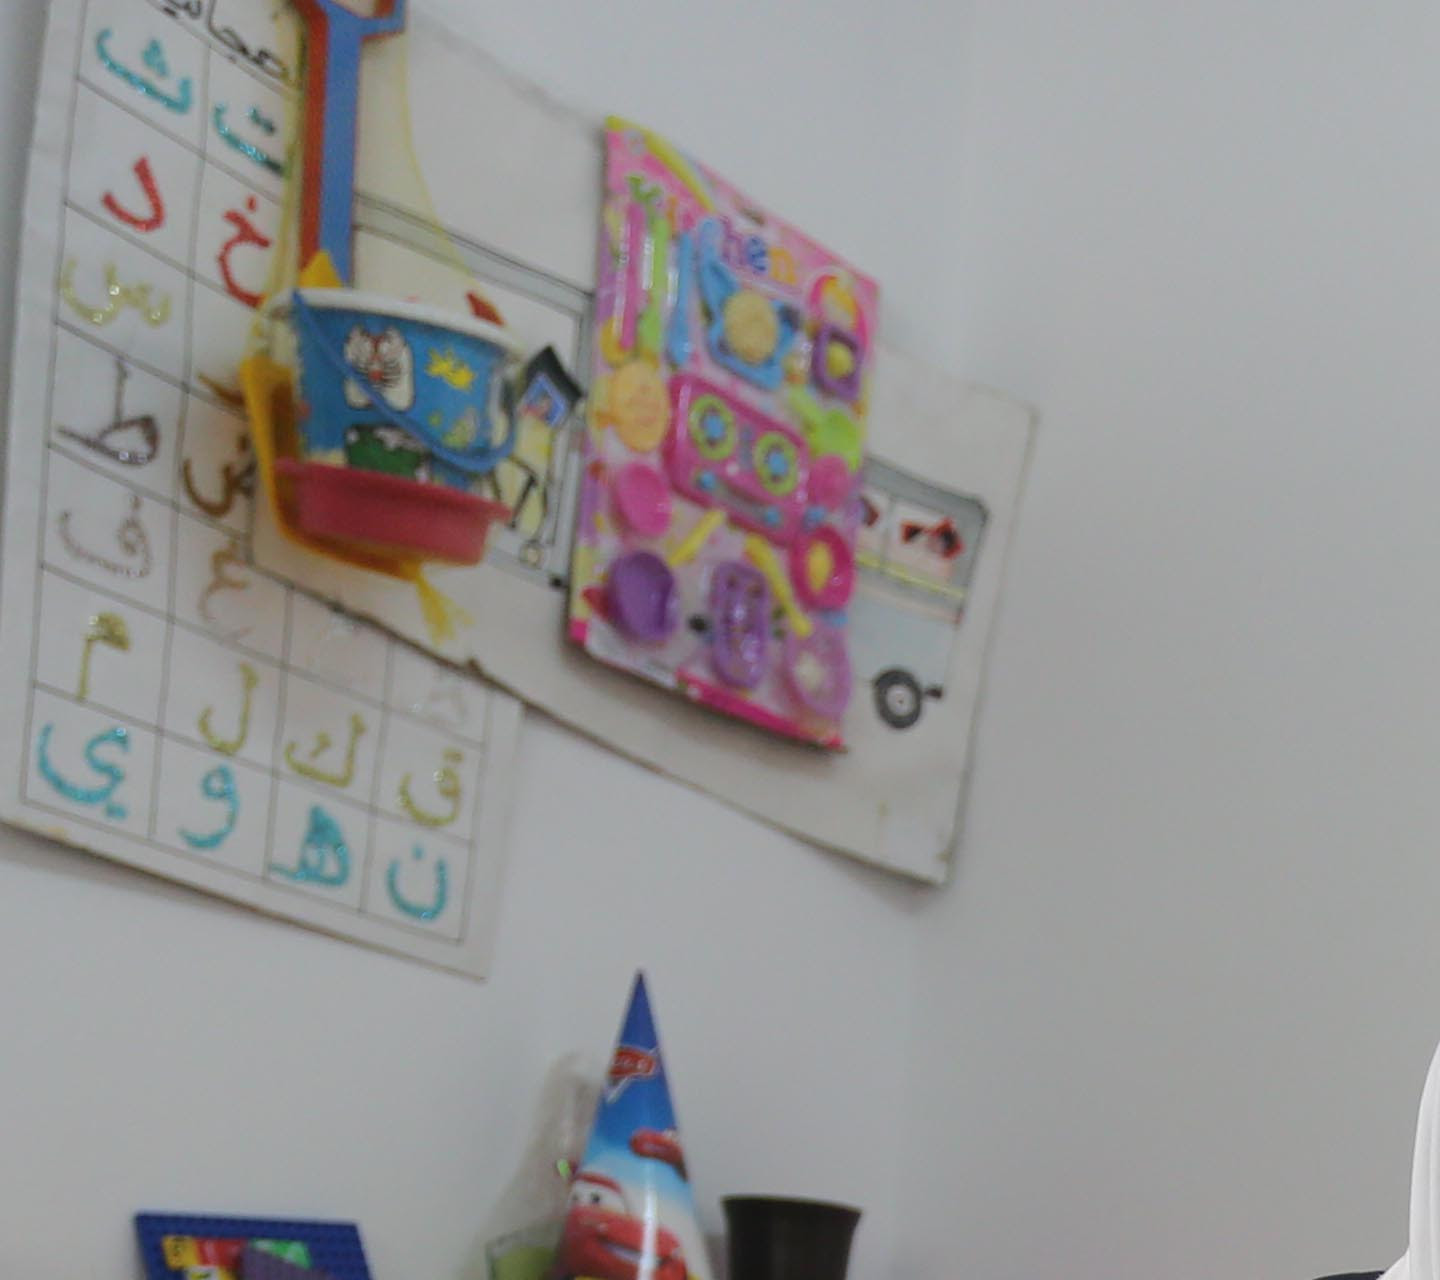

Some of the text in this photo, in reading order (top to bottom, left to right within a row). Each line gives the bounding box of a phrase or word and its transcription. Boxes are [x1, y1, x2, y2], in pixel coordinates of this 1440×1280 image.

[96, 28, 193, 116] ث
[102, 156, 166, 232] د
[75, 611, 132, 702] م
[198, 661, 257, 757] ل
[284, 712, 366, 789] ك
[37, 722, 131, 821] ي
[177, 765, 241, 850] و
[386, 844, 449, 922] ن
